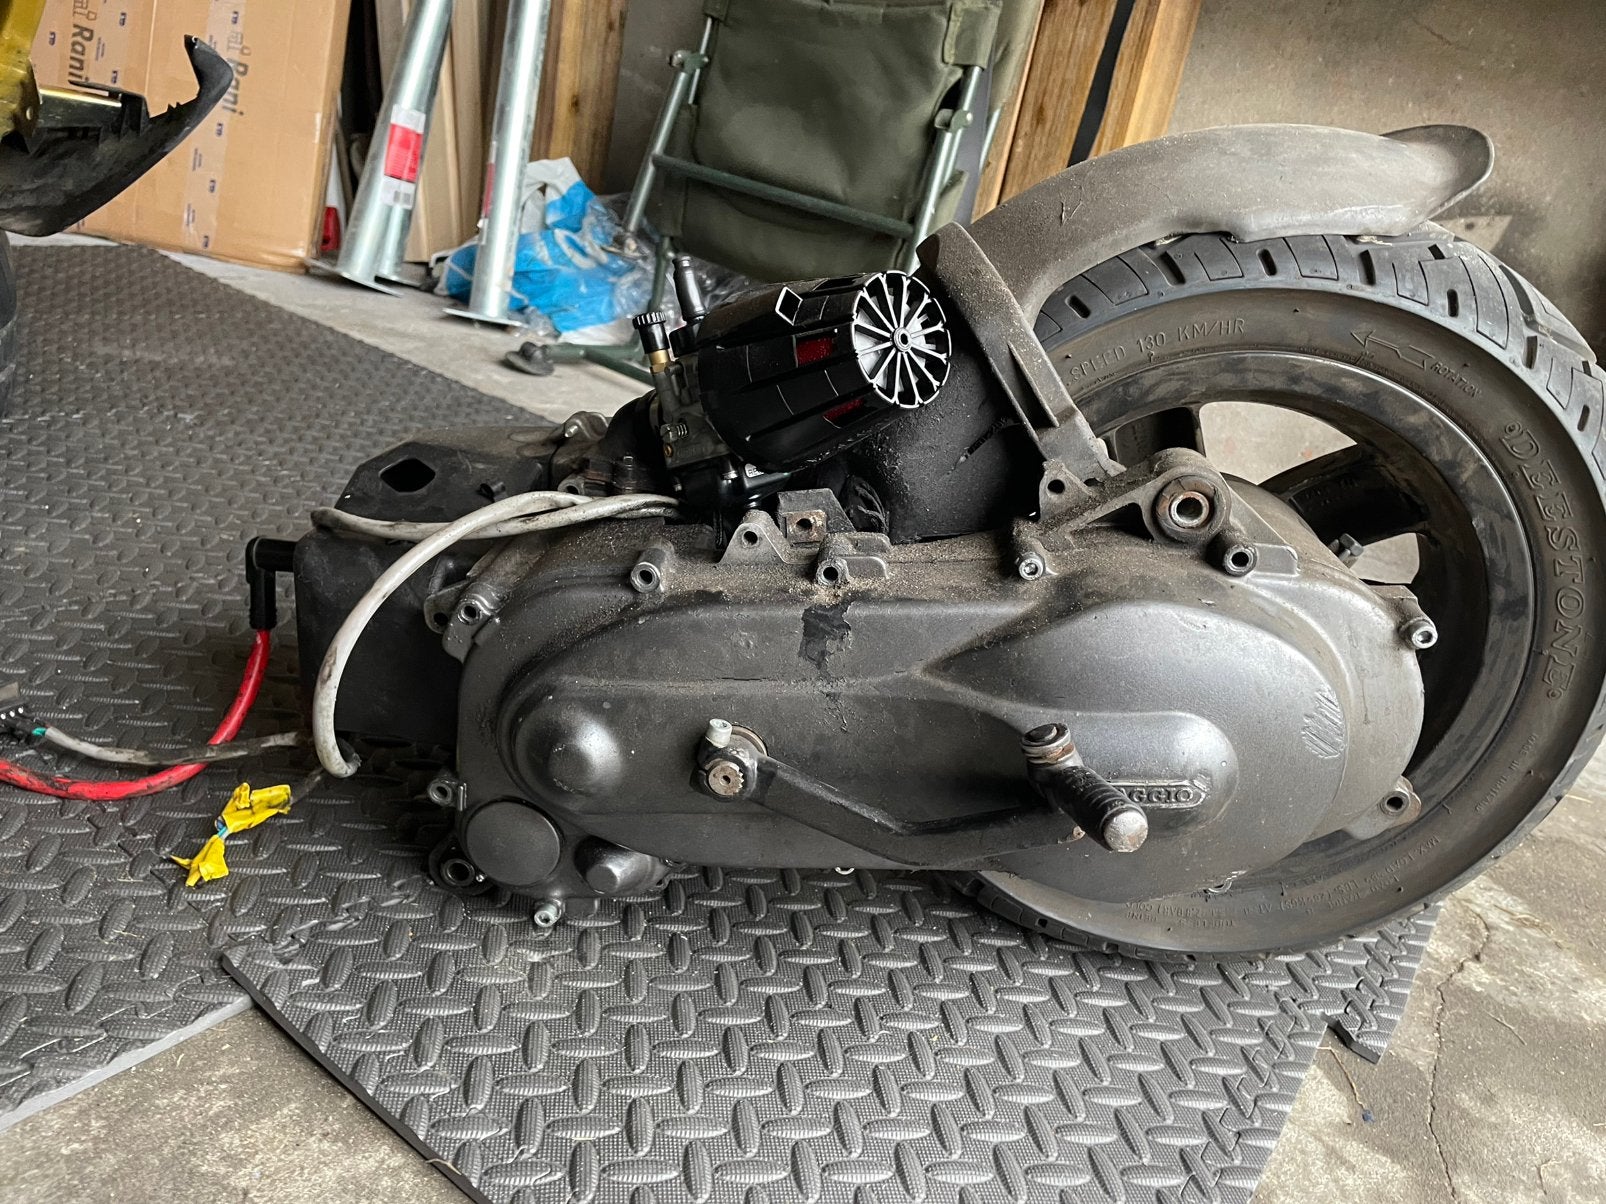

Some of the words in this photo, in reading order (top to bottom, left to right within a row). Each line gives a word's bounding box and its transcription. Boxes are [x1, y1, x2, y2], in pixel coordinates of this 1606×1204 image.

[69, 23, 94, 82] Rani
[1070, 345, 1125, 382] SPEED
[1136, 331, 1167, 353] 130
[1177, 318, 1246, 342] KM/HR
[1430, 361, 1482, 399] ROTATION
[1500, 428, 1585, 690] DEESTONE
